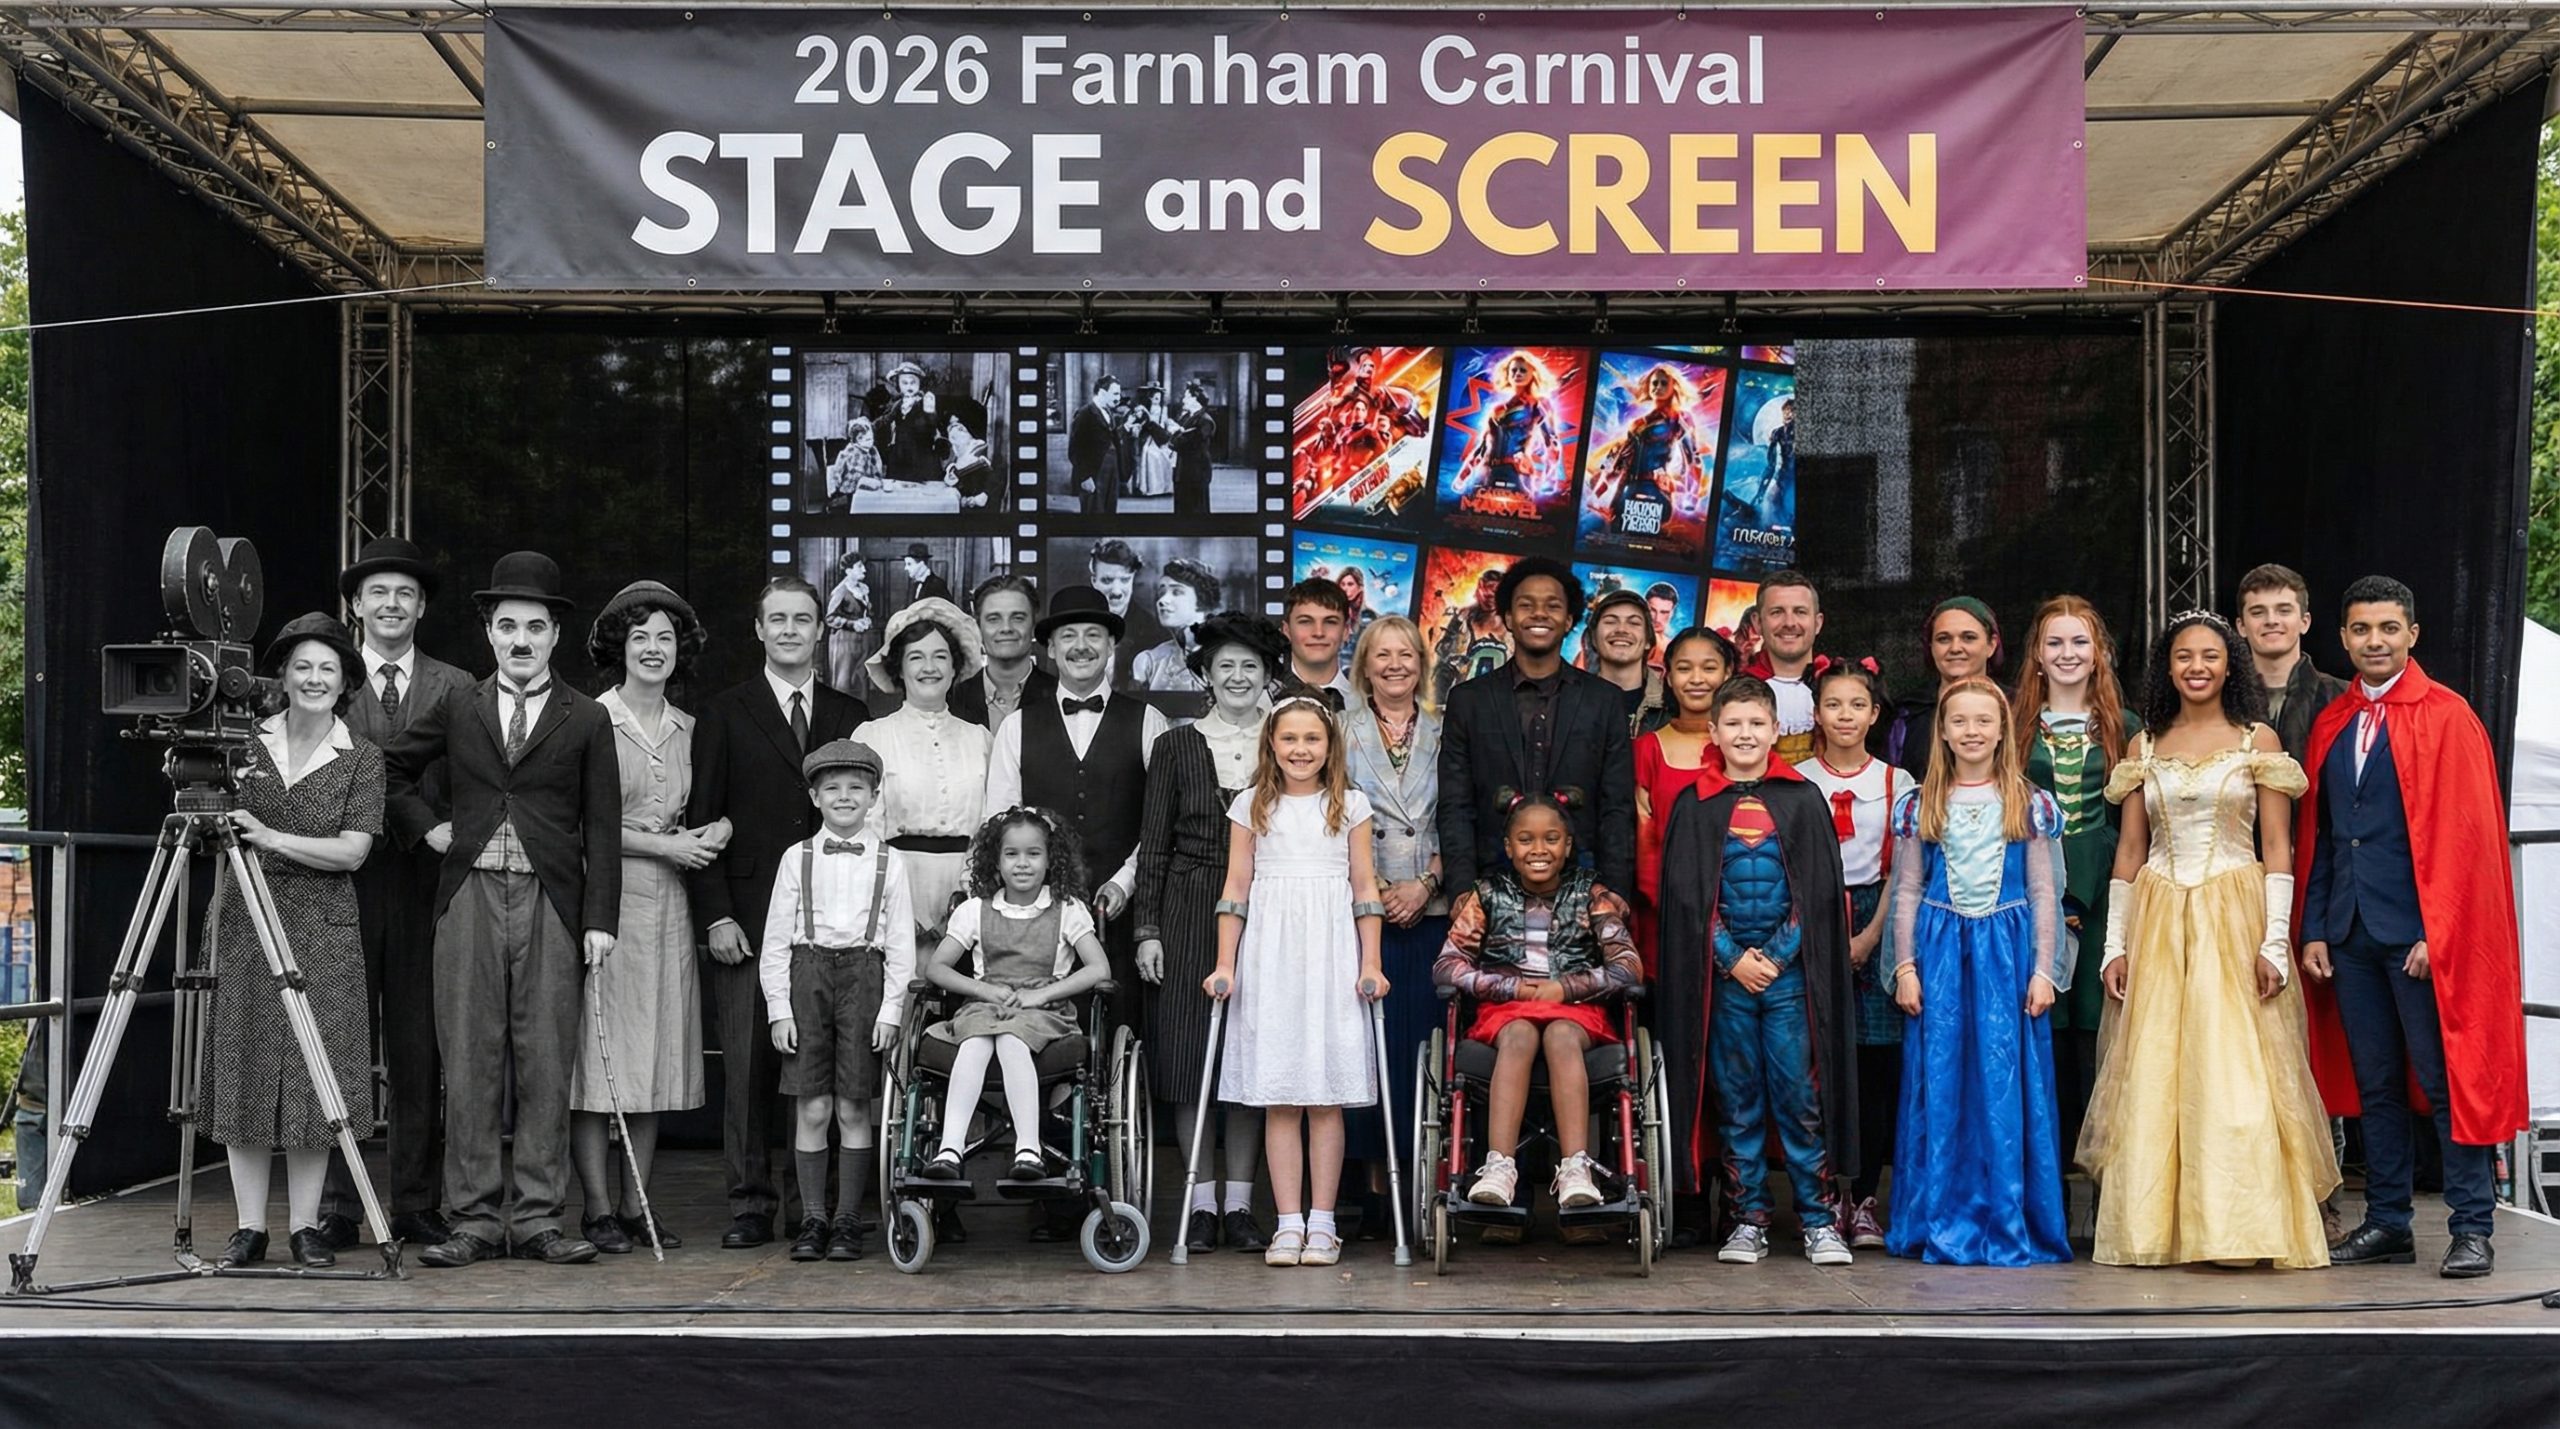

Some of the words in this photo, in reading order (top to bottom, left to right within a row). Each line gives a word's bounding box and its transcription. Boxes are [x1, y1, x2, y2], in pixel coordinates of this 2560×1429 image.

[794, 34, 990, 105] 2026
[1021, 35, 1388, 105] Farnham
[1419, 34, 1764, 106] Carnival
[630, 131, 1102, 256] STAGE
[1144, 147, 1321, 232] and
[1364, 131, 1938, 256] SCREEN
